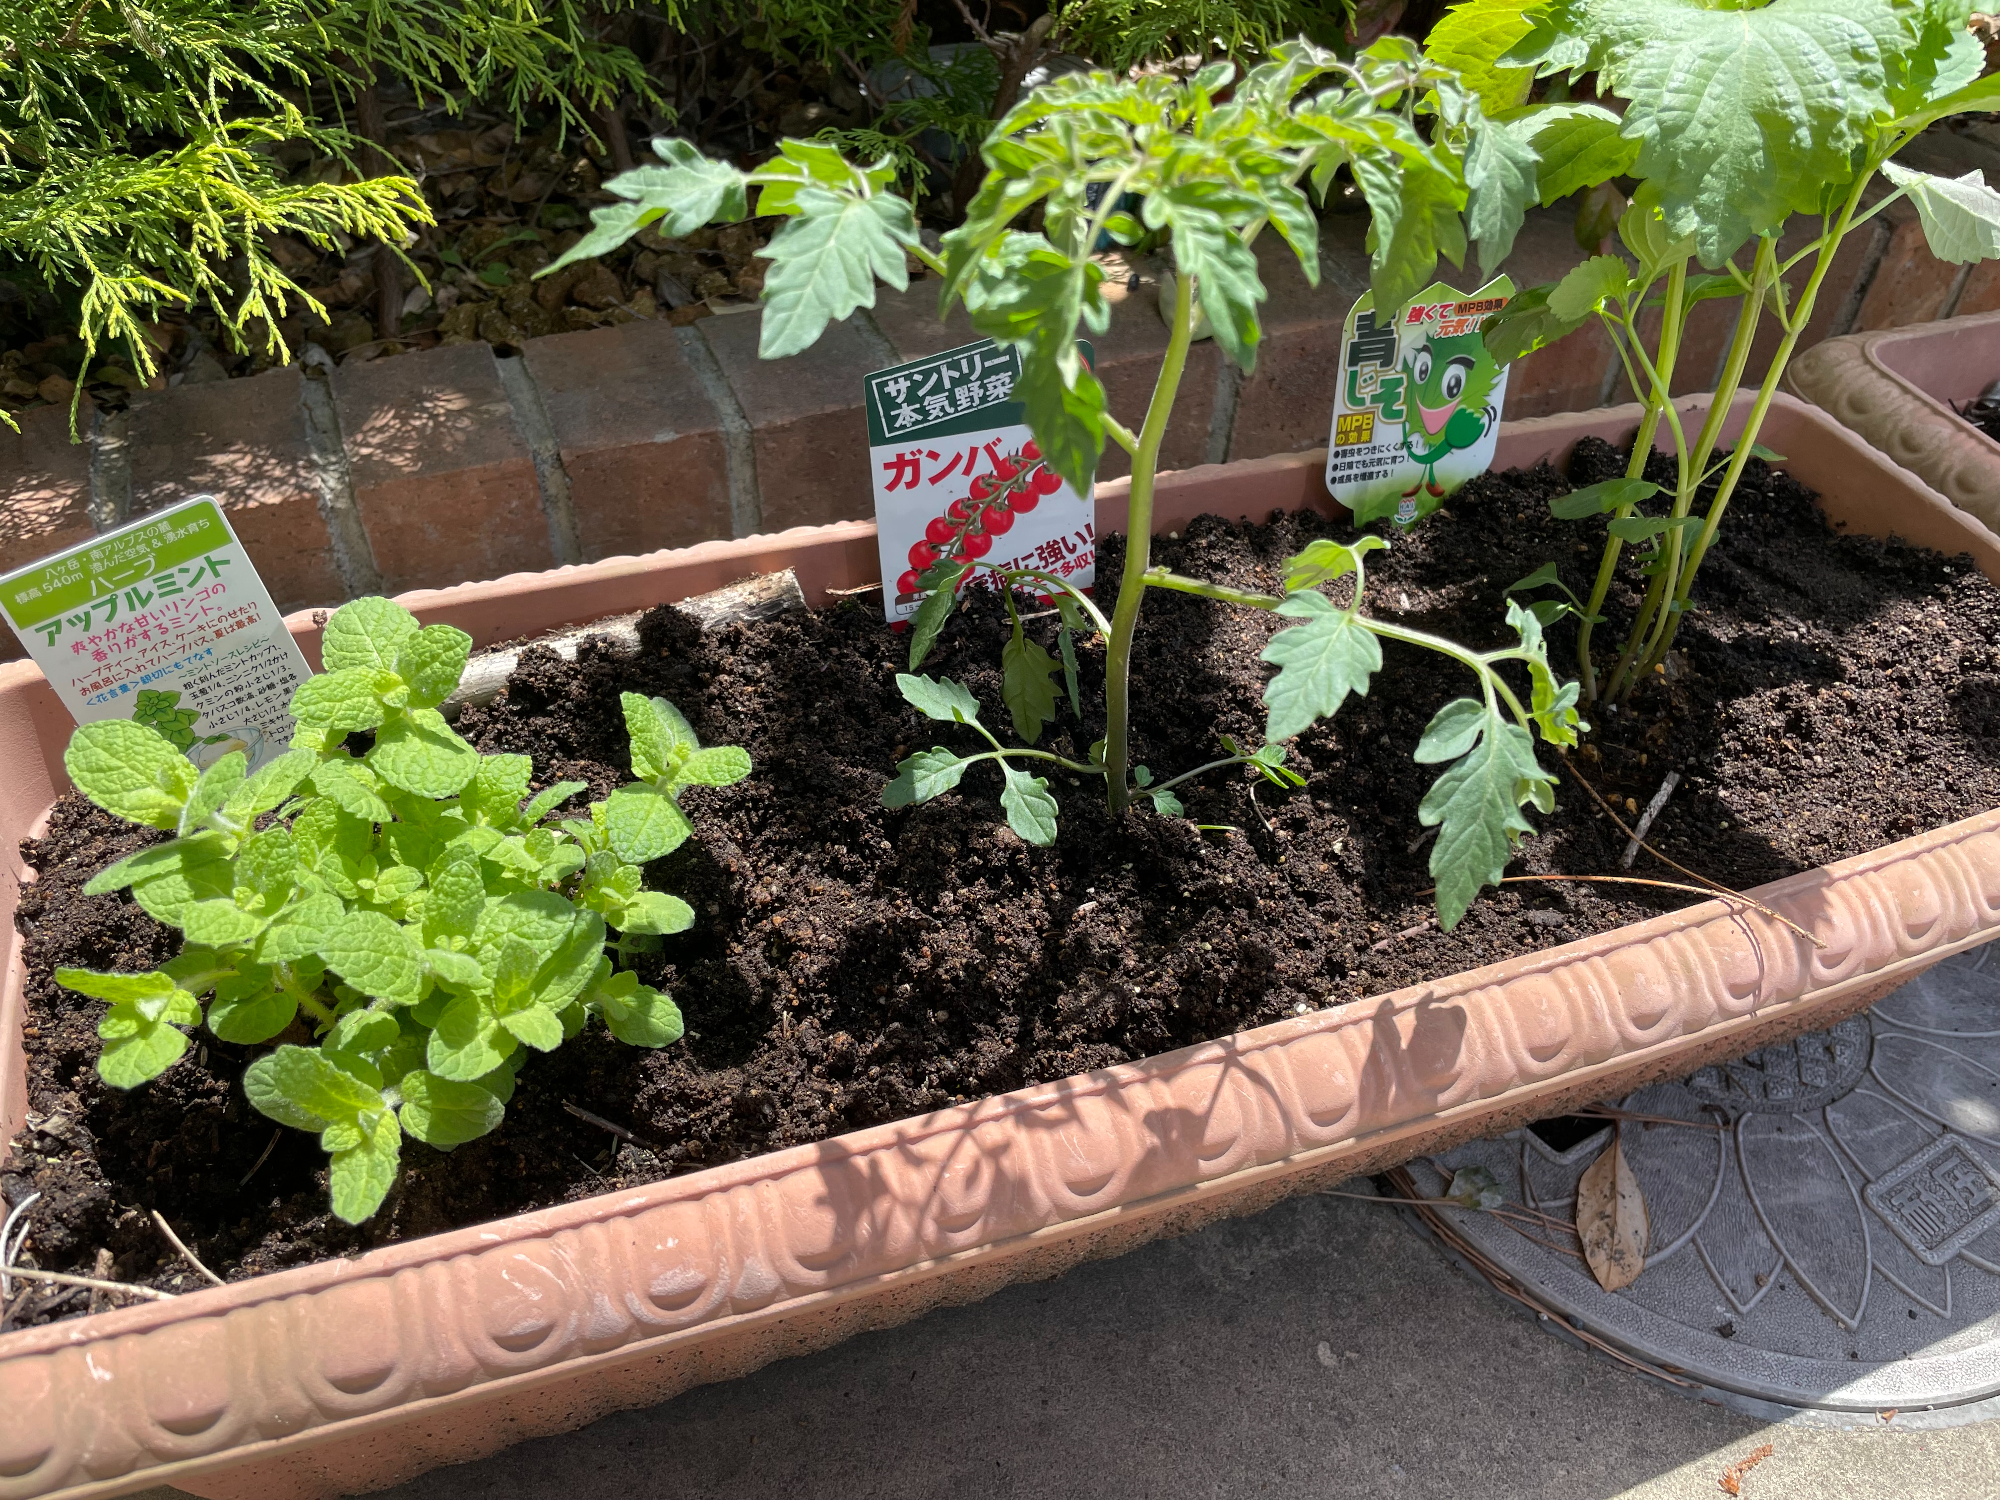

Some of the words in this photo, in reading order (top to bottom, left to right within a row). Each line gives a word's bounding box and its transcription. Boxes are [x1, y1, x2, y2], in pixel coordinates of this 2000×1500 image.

[1457, 298, 1504, 314] MPB効果
[884, 354, 1010, 404] サントリー
[890, 371, 1016, 429] 本気野菜
[1336, 431, 1371, 445] の効果
[1337, 413, 1374, 433] MPB
[14, 587, 43, 605] 標高
[42, 571, 84, 593] 540m
[89, 543, 151, 575] 澄んだ空気
[151, 538, 163, 549] &
[163, 518, 210, 545] 湧水育ち
[91, 552, 156, 597] ハーブ
[34, 555, 231, 648] アップルミント
[70, 583, 226, 656] 爽やかな甘いリンゴの
[72, 601, 258, 688] ハーブティー、アイス、ケーキにのせたり
[91, 605, 223, 663] 香りがするミント。
